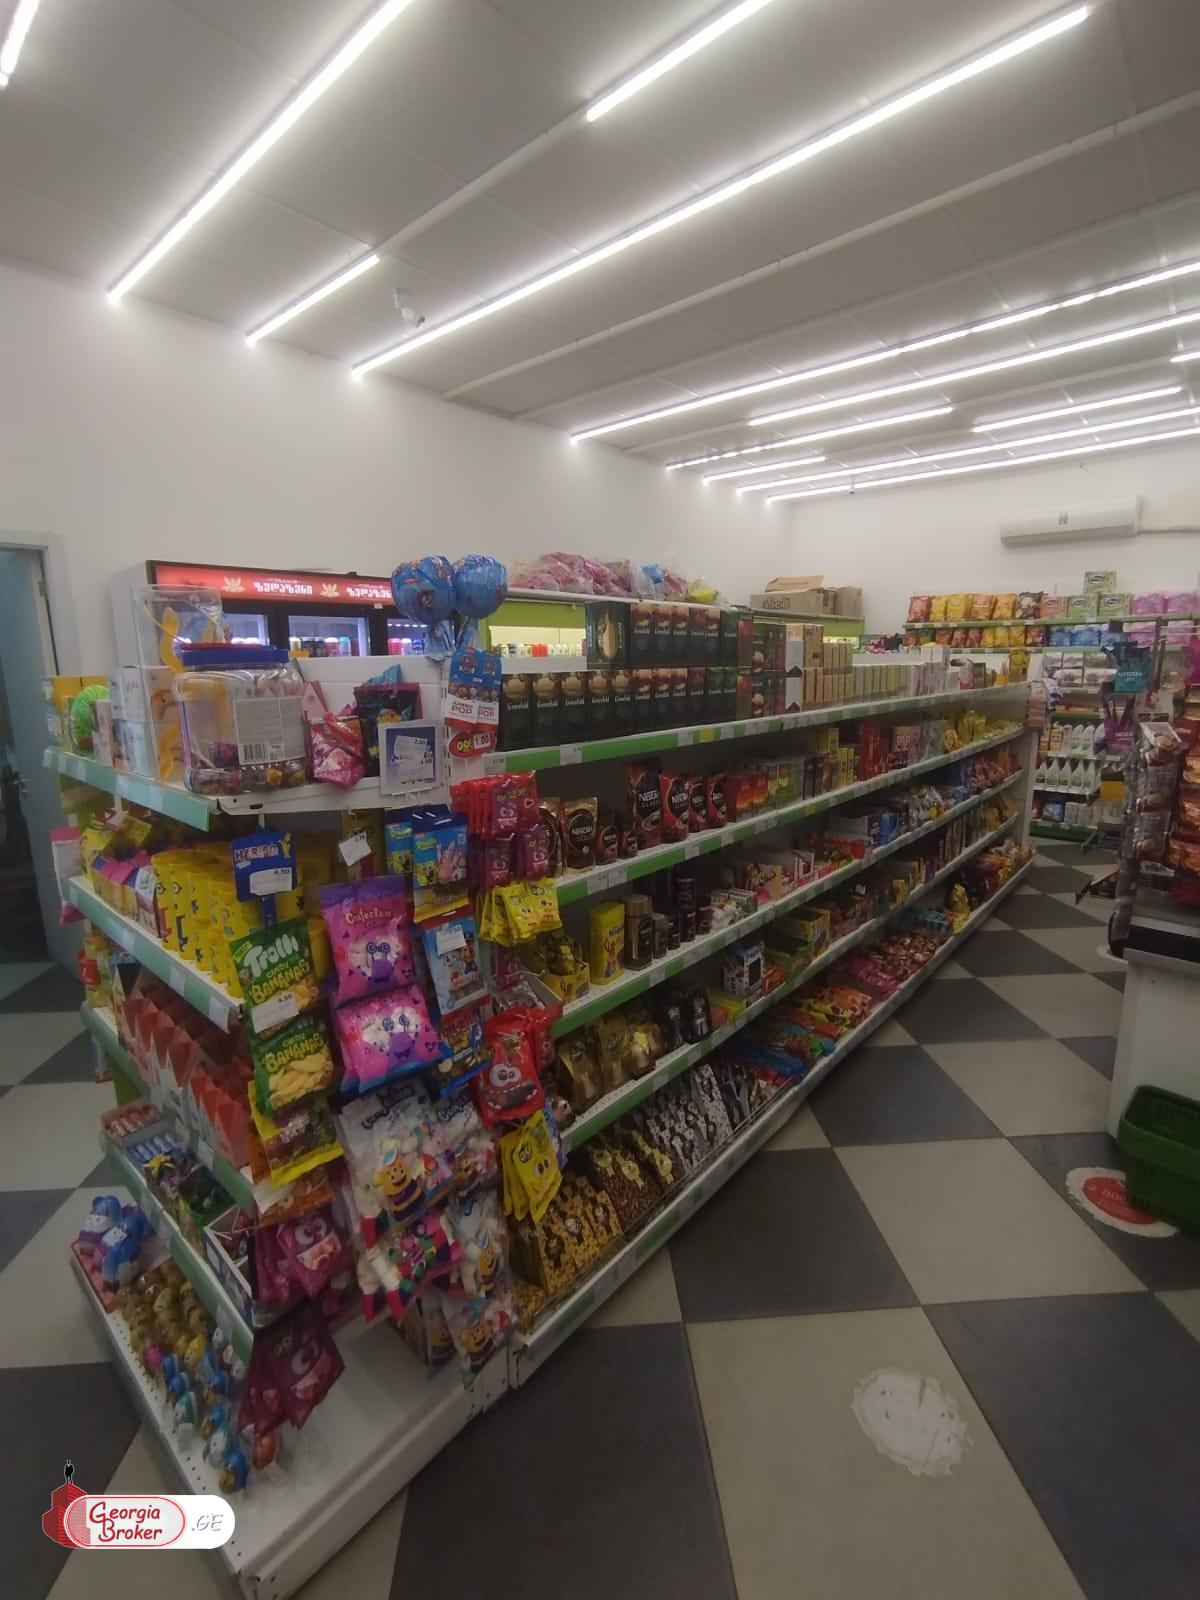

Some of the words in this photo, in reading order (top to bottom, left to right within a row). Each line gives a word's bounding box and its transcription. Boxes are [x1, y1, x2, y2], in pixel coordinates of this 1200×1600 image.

[451, 705, 473, 715] POP
[477, 709, 495, 718] POP
[243, 934, 299, 978] Trolli
[251, 958, 310, 1004] BANANAS
[263, 1032, 324, 1073] BANANAS
